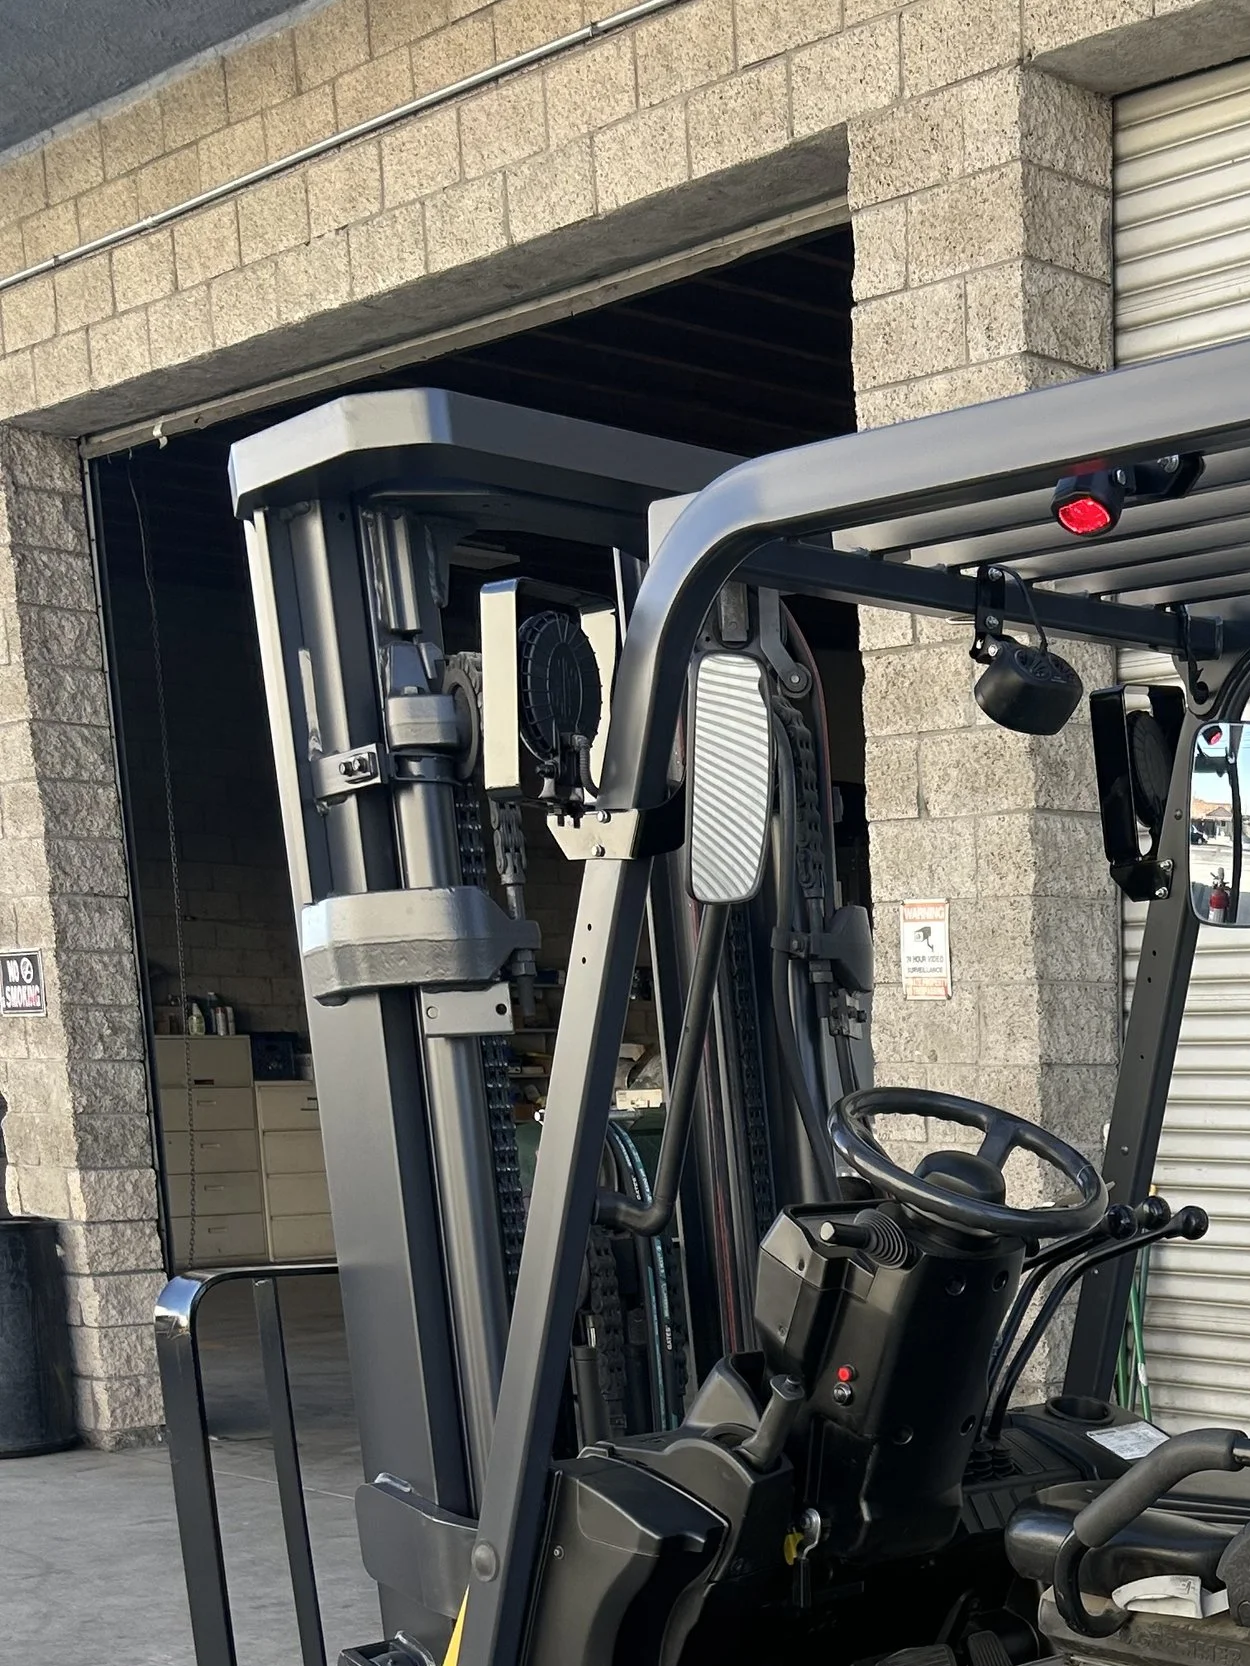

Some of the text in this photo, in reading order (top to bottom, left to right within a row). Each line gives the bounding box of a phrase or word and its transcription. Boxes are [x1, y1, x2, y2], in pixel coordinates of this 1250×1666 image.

[903, 906, 945, 921] WARNING
[913, 955, 926, 964] HOUR
[928, 955, 944, 964] VIDEO
[6, 959, 20, 983] NO
[907, 966, 943, 974] SURVEILLANCE
[5, 984, 41, 1008] SMOKING
[665, 1324, 673, 1351] GATES
